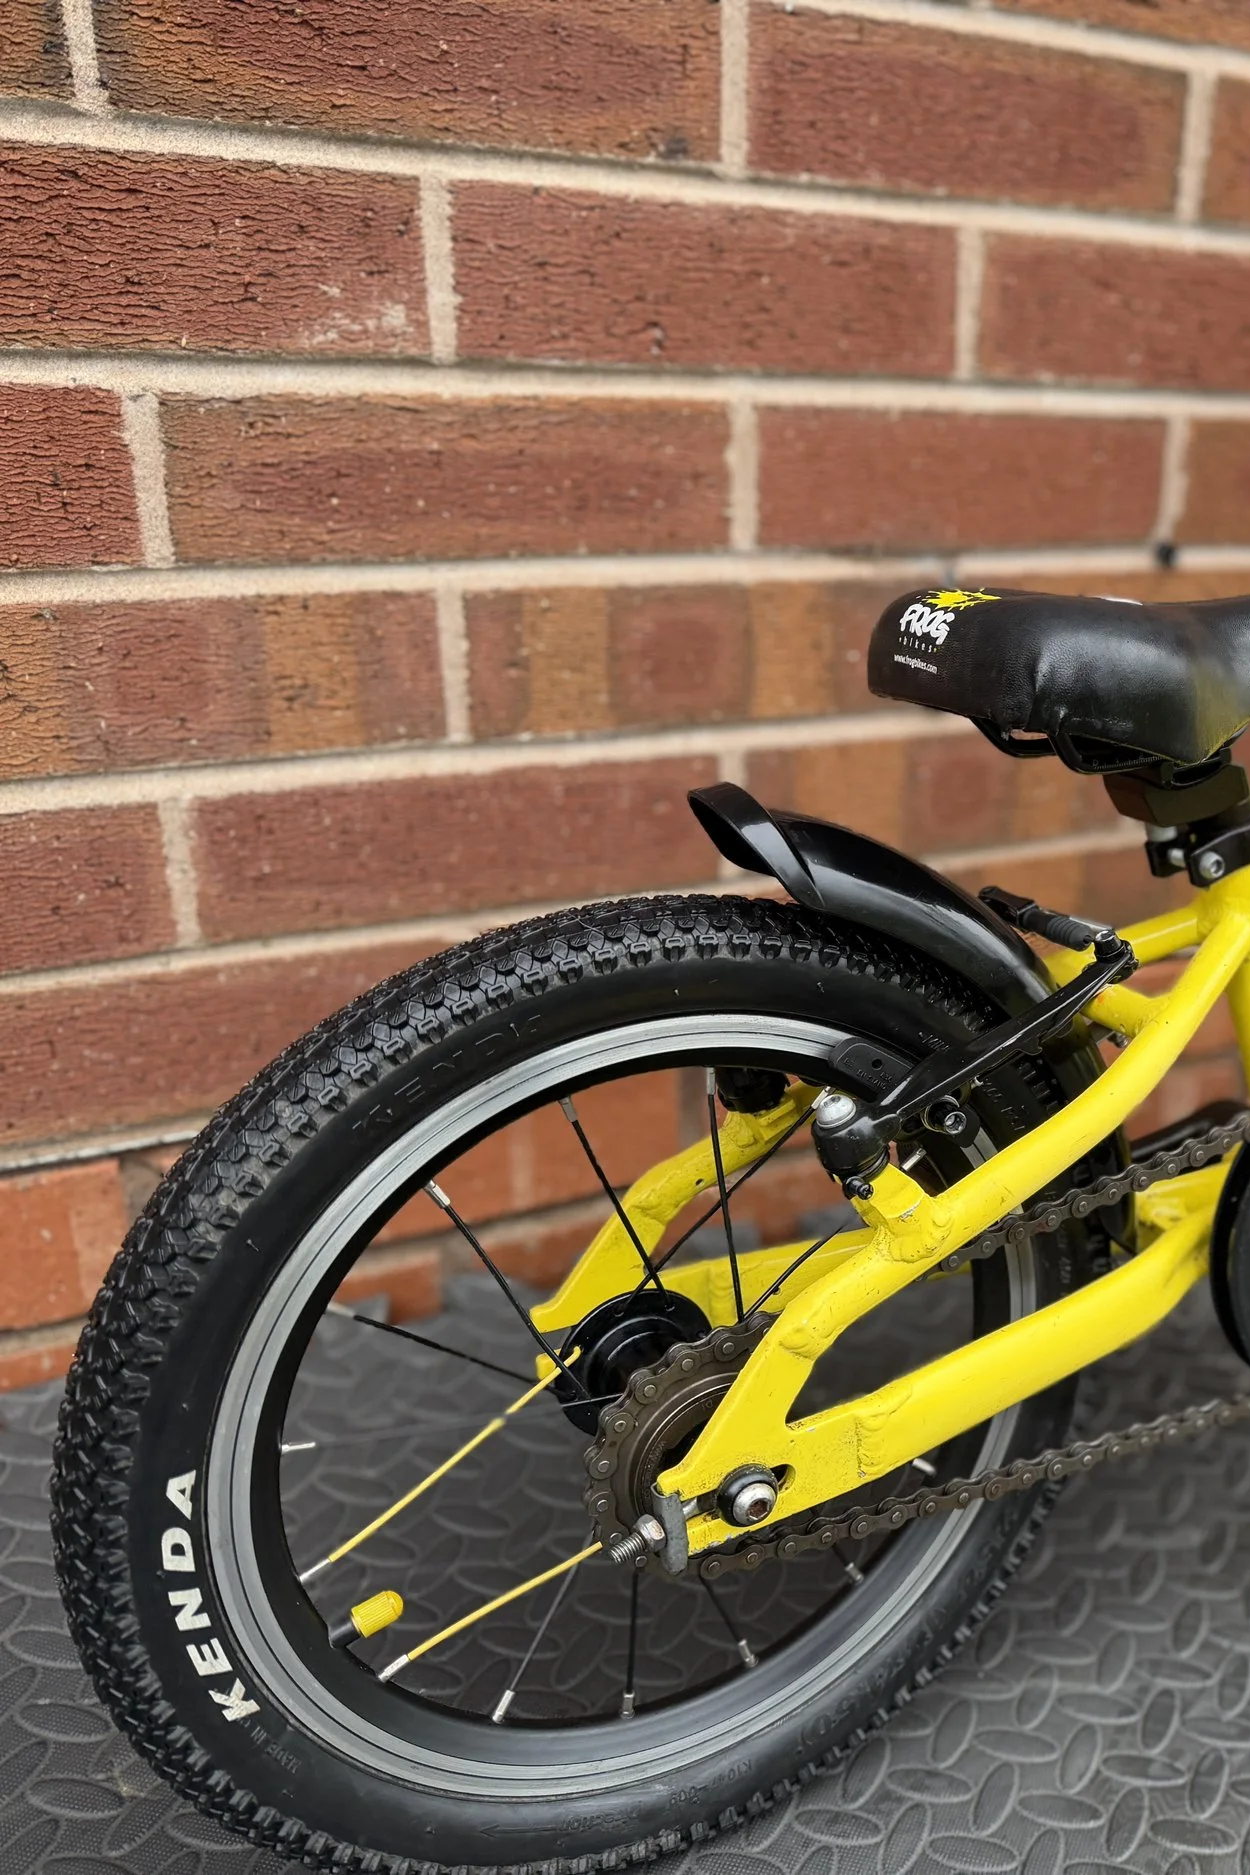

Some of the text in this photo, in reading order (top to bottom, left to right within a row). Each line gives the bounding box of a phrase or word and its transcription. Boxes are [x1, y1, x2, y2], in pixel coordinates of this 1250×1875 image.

[899, 603, 955, 645] FROG
[894, 653, 938, 675] www.frogbikes.com
[160, 1469, 260, 1721] KENDA
